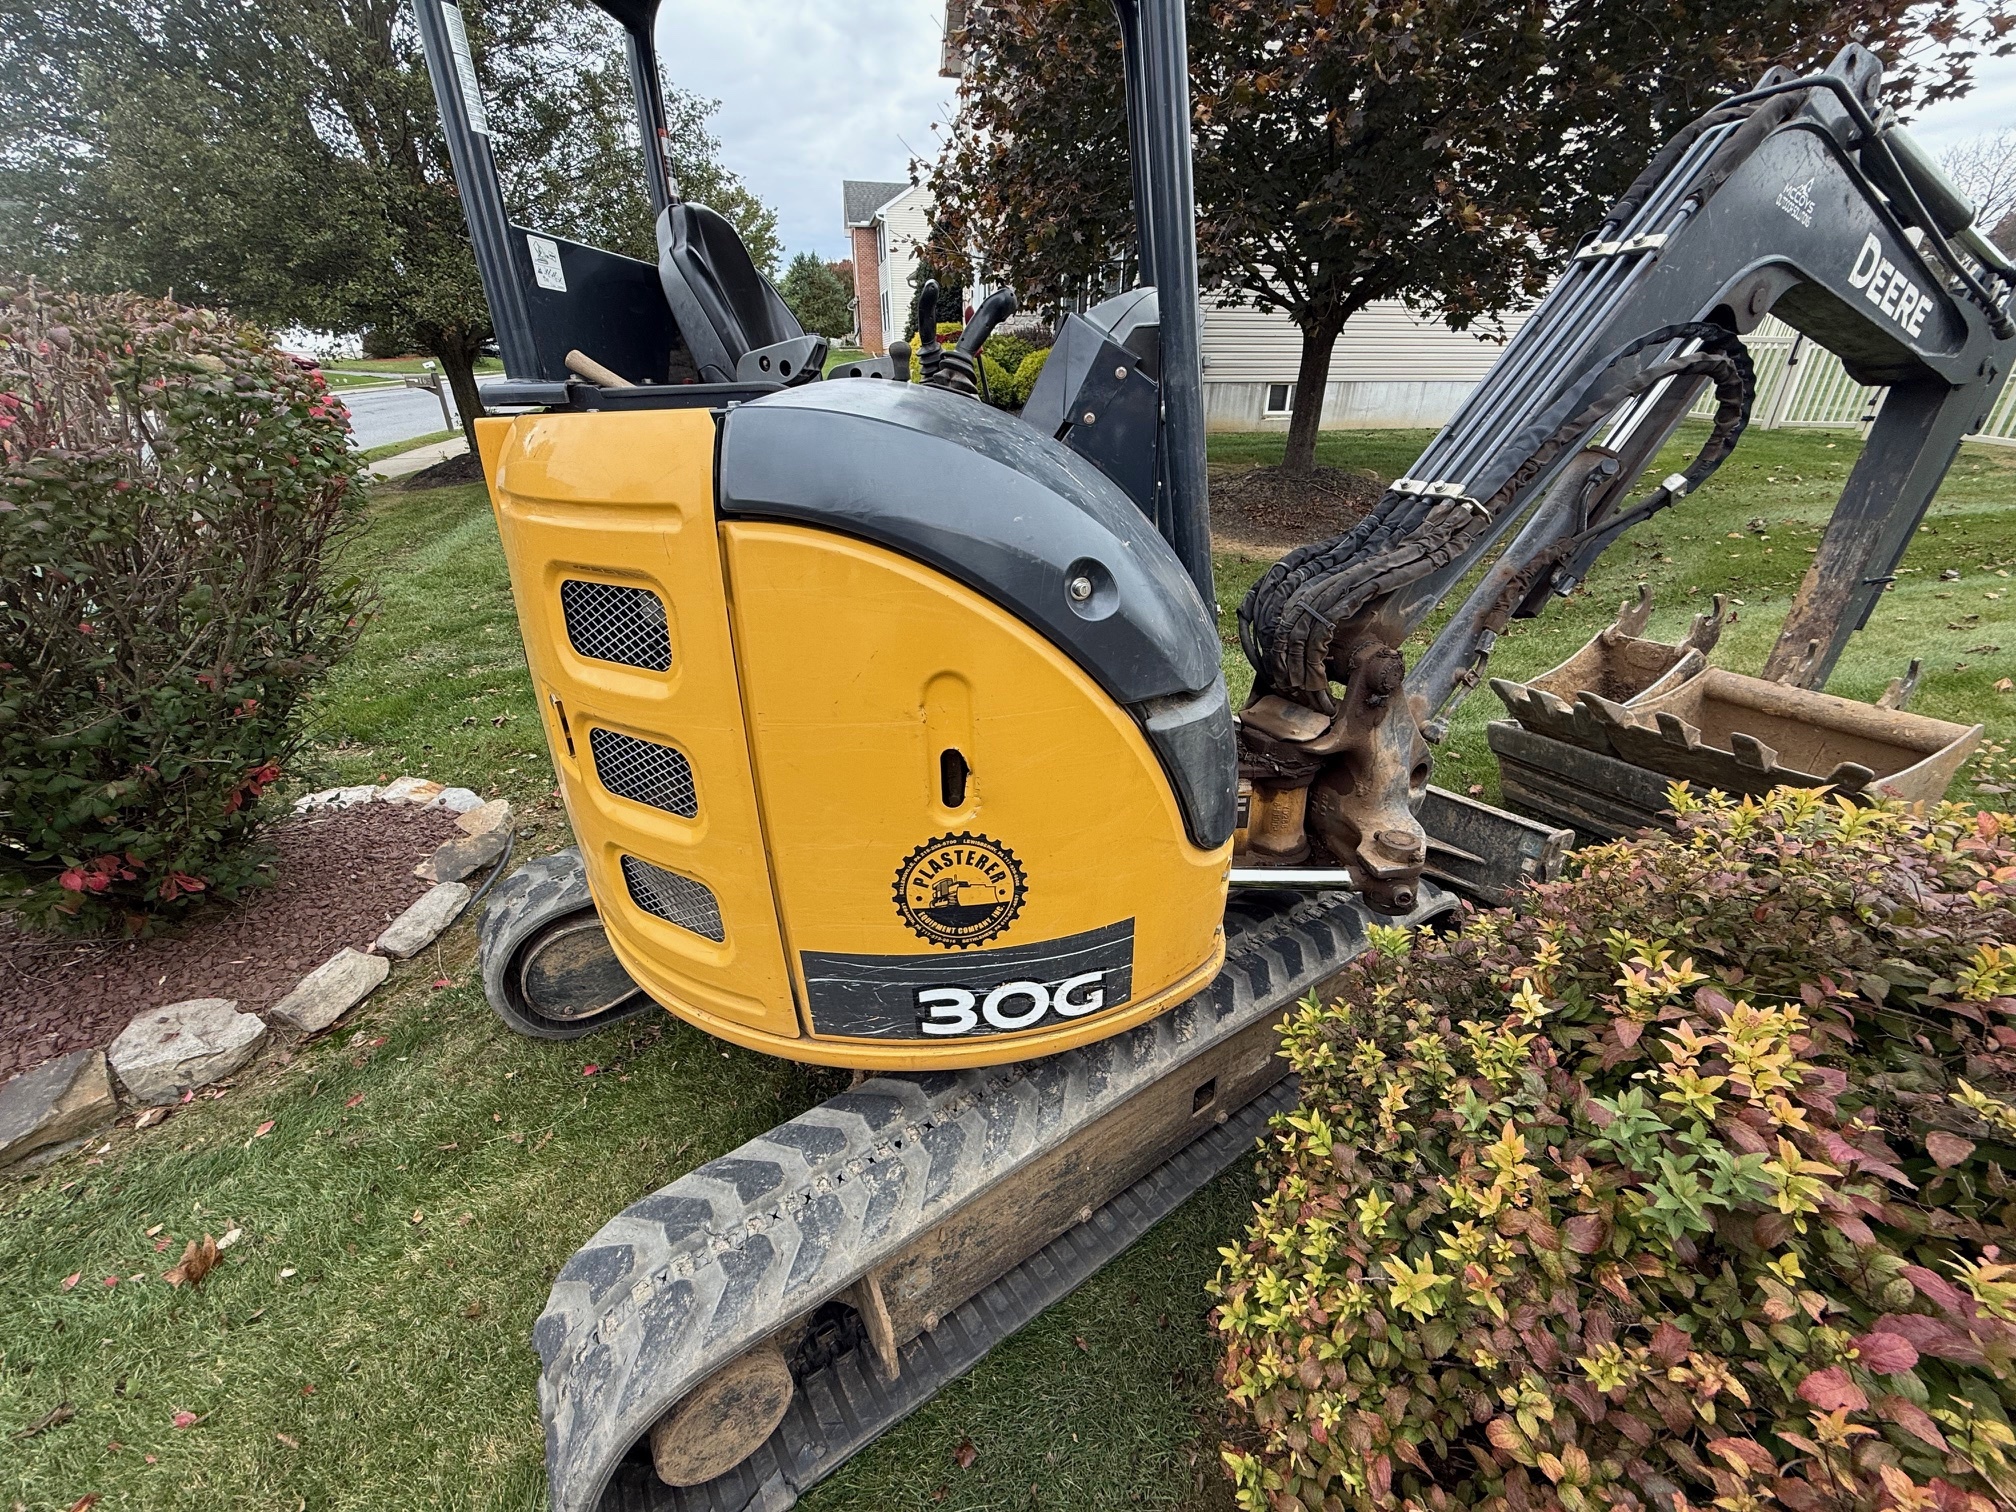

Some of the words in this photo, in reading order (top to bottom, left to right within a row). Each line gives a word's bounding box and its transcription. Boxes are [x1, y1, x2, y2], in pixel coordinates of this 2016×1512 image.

[1783, 182, 1816, 214] MCCOYS
[1847, 232, 1934, 339] DEERE
[912, 849, 1007, 889] PLASTERER
[917, 911, 957, 935] EQUIPMENT
[957, 917, 995, 935] COMPANY,
[991, 905, 1006, 919] INC.
[918, 970, 1104, 1036] 30G
